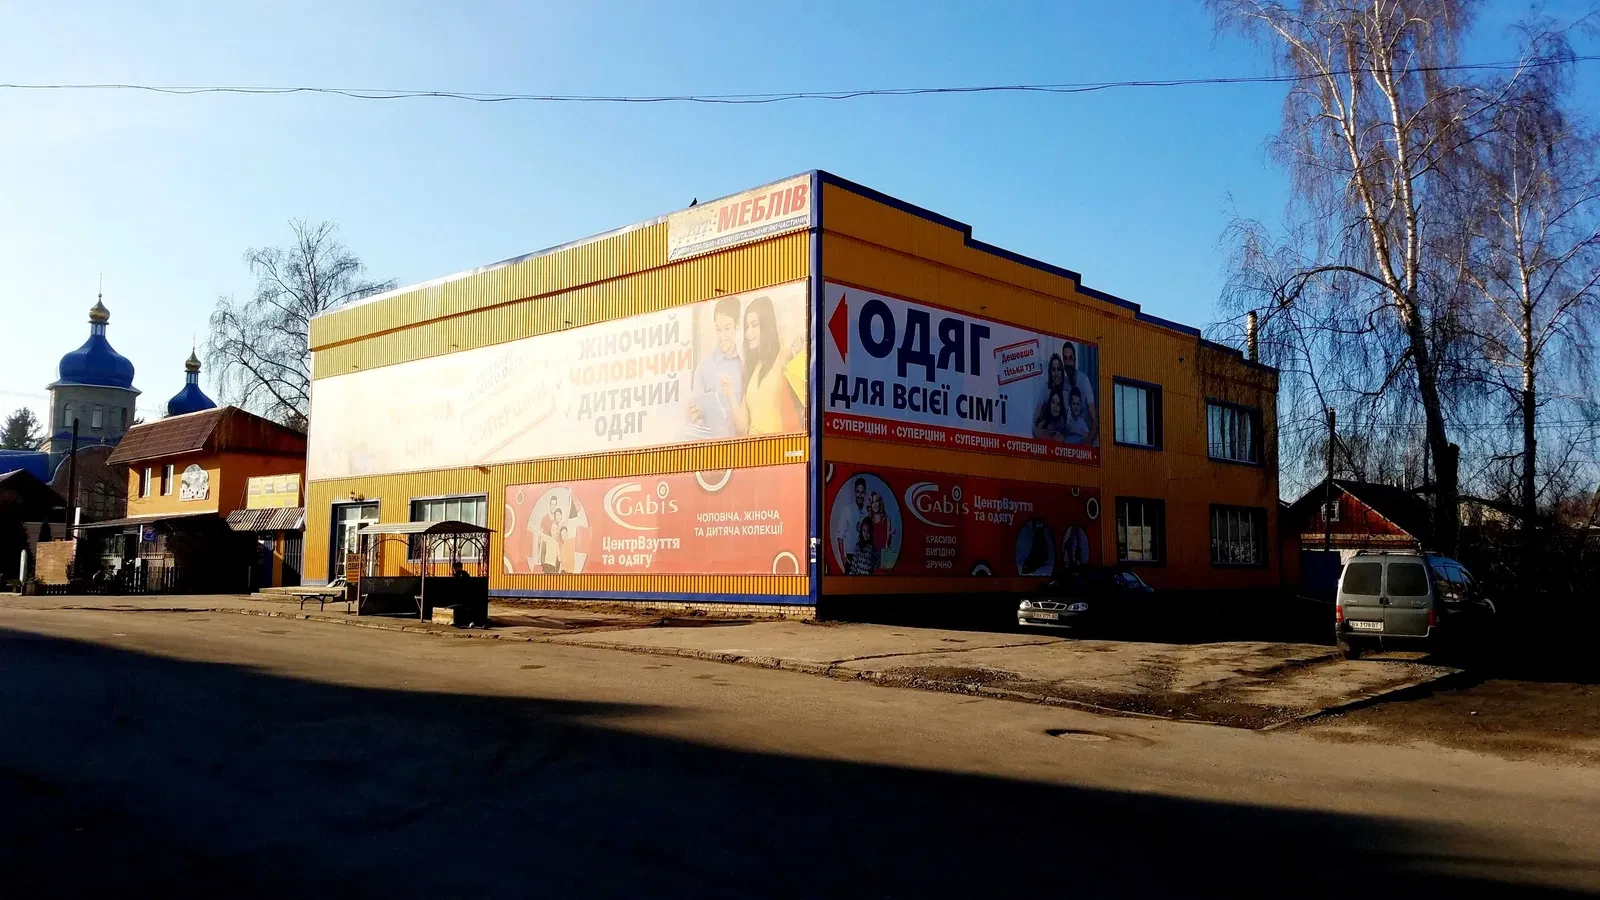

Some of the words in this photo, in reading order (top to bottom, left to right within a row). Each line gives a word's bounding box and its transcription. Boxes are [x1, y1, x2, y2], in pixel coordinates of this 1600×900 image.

[717, 184, 808, 233] МЕБЛІВ
[579, 314, 679, 360] ЖІНОЧИЙ
[859, 299, 990, 382] ОДЯГ
[569, 340, 693, 386] ЧОЛОВІЧИЙ
[1001, 347, 1034, 364] Дешевше
[1024, 362, 1036, 373] тут
[578, 373, 679, 420] ДИТЯЧИЙ
[830, 374, 885, 410] ДЛЯ
[893, 383, 951, 416] ВСІЄЇ
[955, 393, 1009, 424] СІМ'Ї
[595, 411, 648, 441] ОДЯГ
[832, 418, 888, 436] СУПЕРЦІНИ
[896, 426, 946, 442] СУПЕРЦІНИ
[955, 433, 1000, 449] СУПЕРЦІНИ
[1006, 441, 1048, 455] СУПЕРЦІНИ
[1054, 446, 1093, 461] СУПЕРЦІНИ
[974, 495, 1034, 514] ЦентрВзуття
[697, 511, 742, 523] ЧОЛОВІЧА,
[744, 509, 780, 521] ЖІНОЧА
[974, 512, 985, 522] та
[987, 511, 1015, 526] одягу
[693, 527, 704, 537] ТА
[706, 526, 740, 538] ДИТЯЧА
[742, 522, 783, 536] КОЛЕКЦІЇ
[602, 535, 681, 553] ЦентрВзуття
[925, 534, 957, 545] КРАСИВО
[602, 553, 615, 566] та
[618, 554, 652, 569] одягу
[925, 547, 956, 558] ВИГІДНО
[925, 560, 953, 570] ЗРУЧНО
